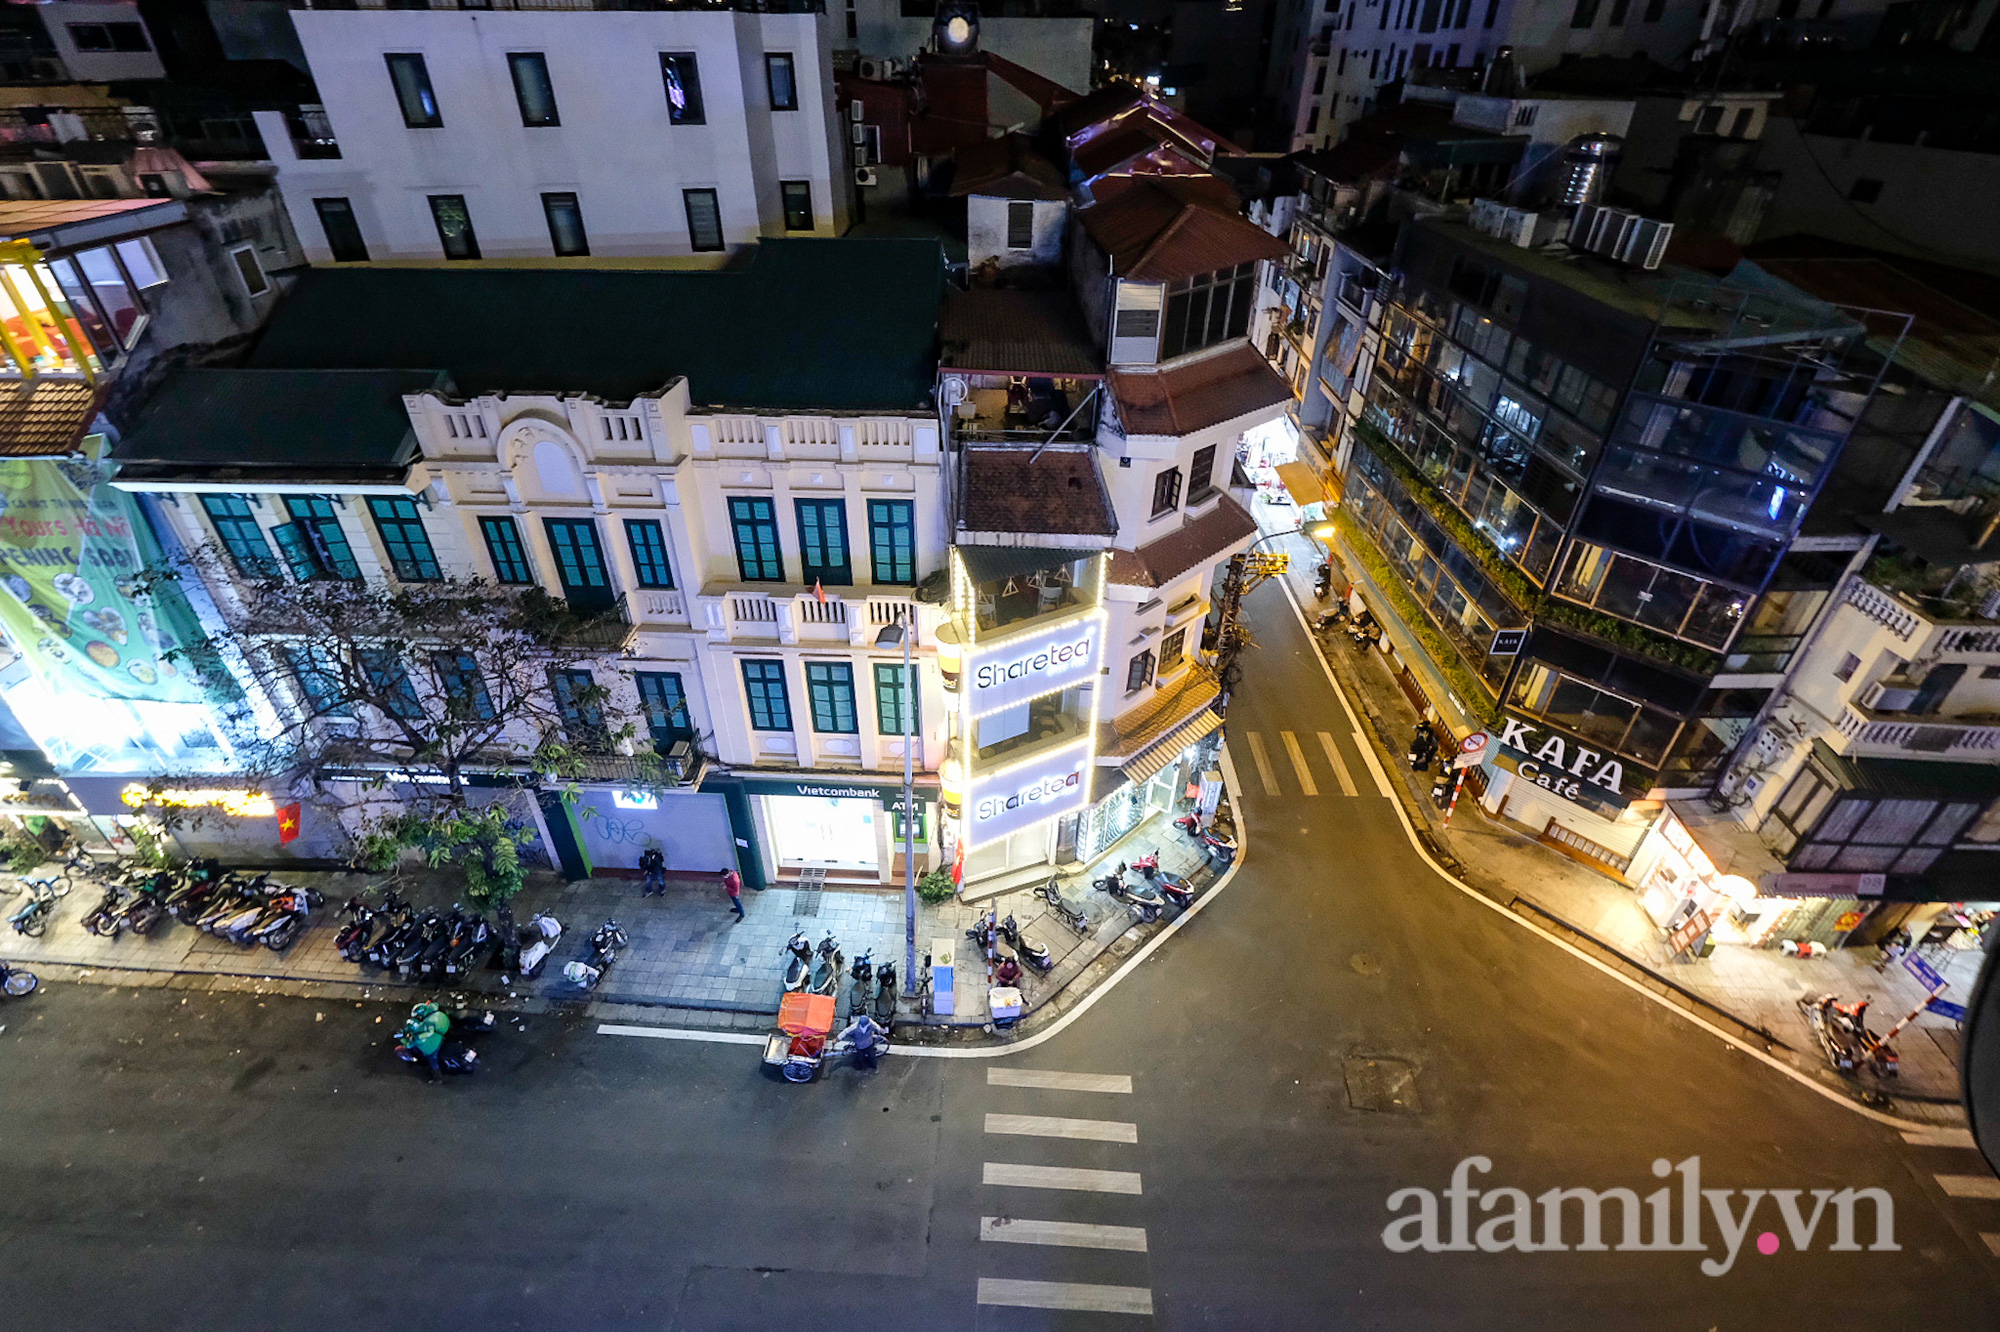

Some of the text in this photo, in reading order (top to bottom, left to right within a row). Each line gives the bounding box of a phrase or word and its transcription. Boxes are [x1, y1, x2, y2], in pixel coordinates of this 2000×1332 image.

[977, 638, 1090, 689] Sharetea
[1499, 716, 1624, 795] KAFA
[796, 784, 880, 798] Vietcombank
[979, 771, 1080, 820] Sharetea
[1517, 761, 1579, 800] Café
